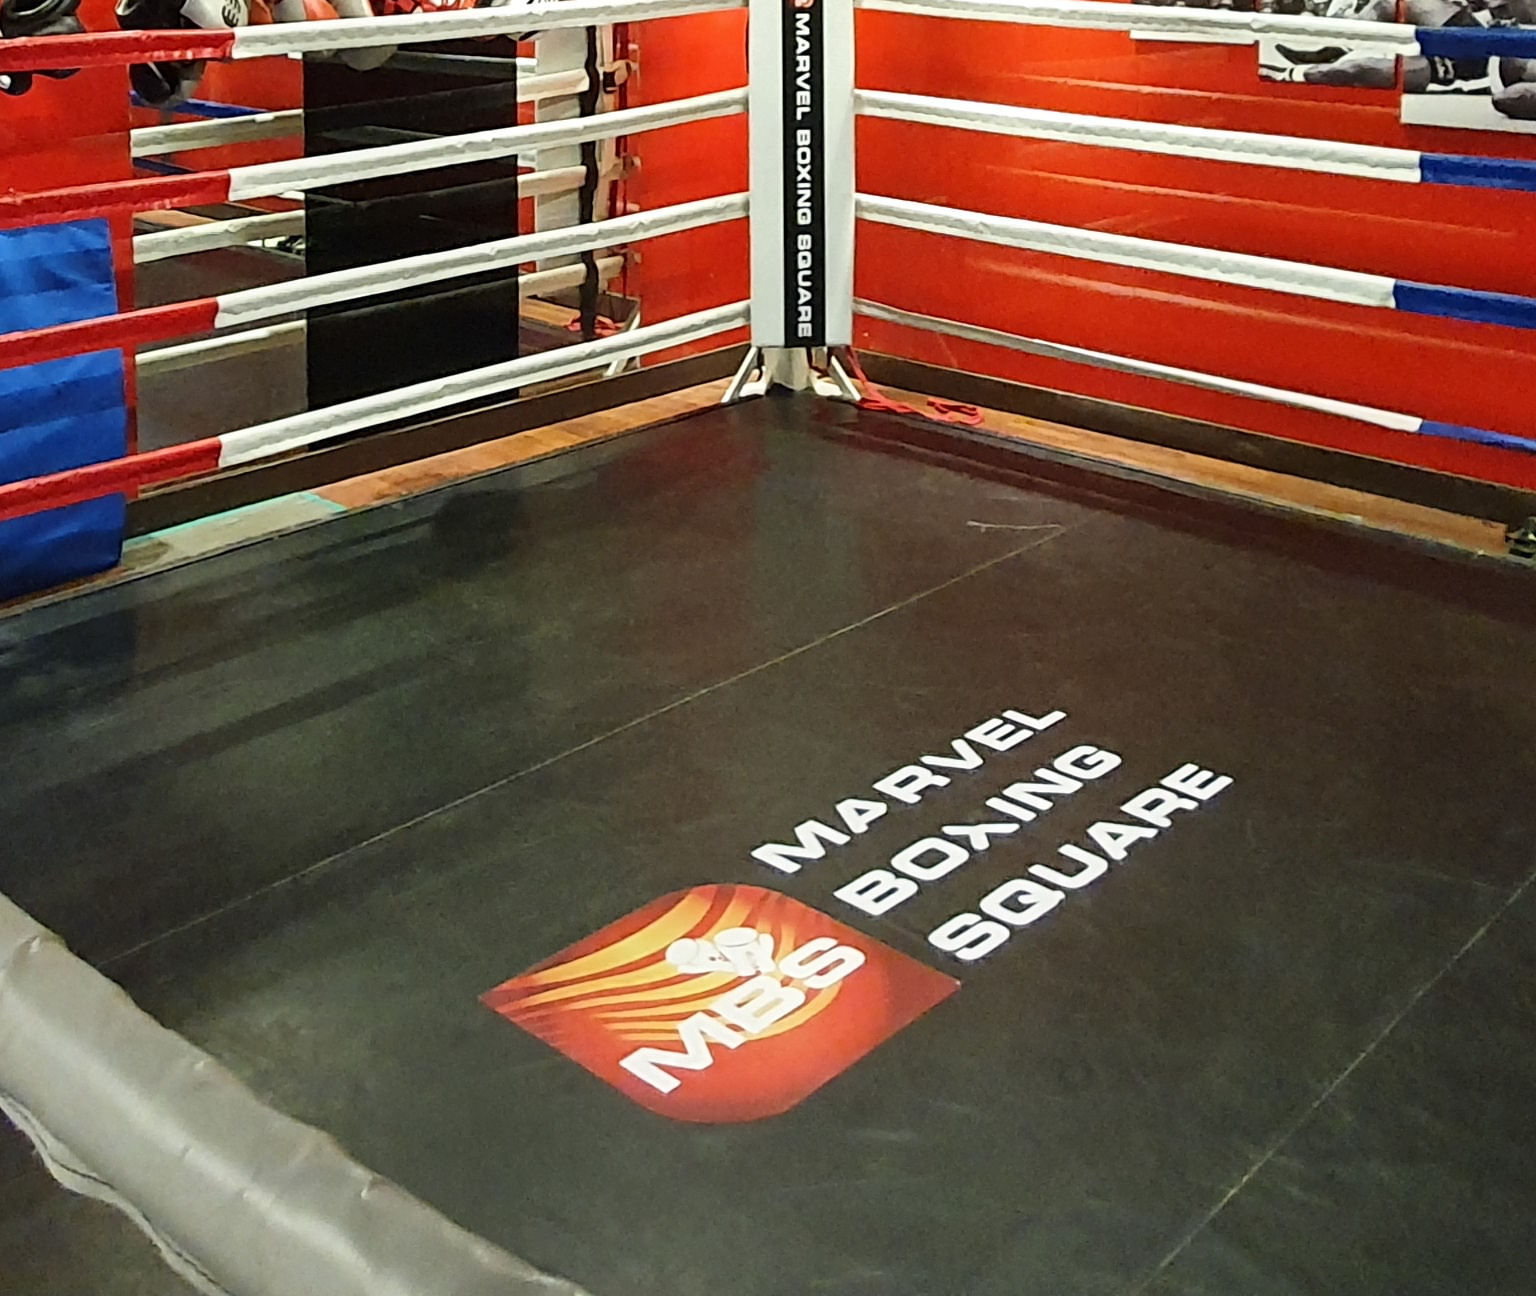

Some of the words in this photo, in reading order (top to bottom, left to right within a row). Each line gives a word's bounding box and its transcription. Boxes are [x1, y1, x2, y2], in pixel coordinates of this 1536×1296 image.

[795, 12, 812, 121] MARVEL
[796, 129, 813, 226] BOXING
[797, 234, 813, 338] SQUARE
[750, 708, 1068, 874] MARVEL
[832, 744, 1123, 917] BOXING
[927, 763, 1235, 962] SQUARE
[618, 936, 866, 1095] MBS
